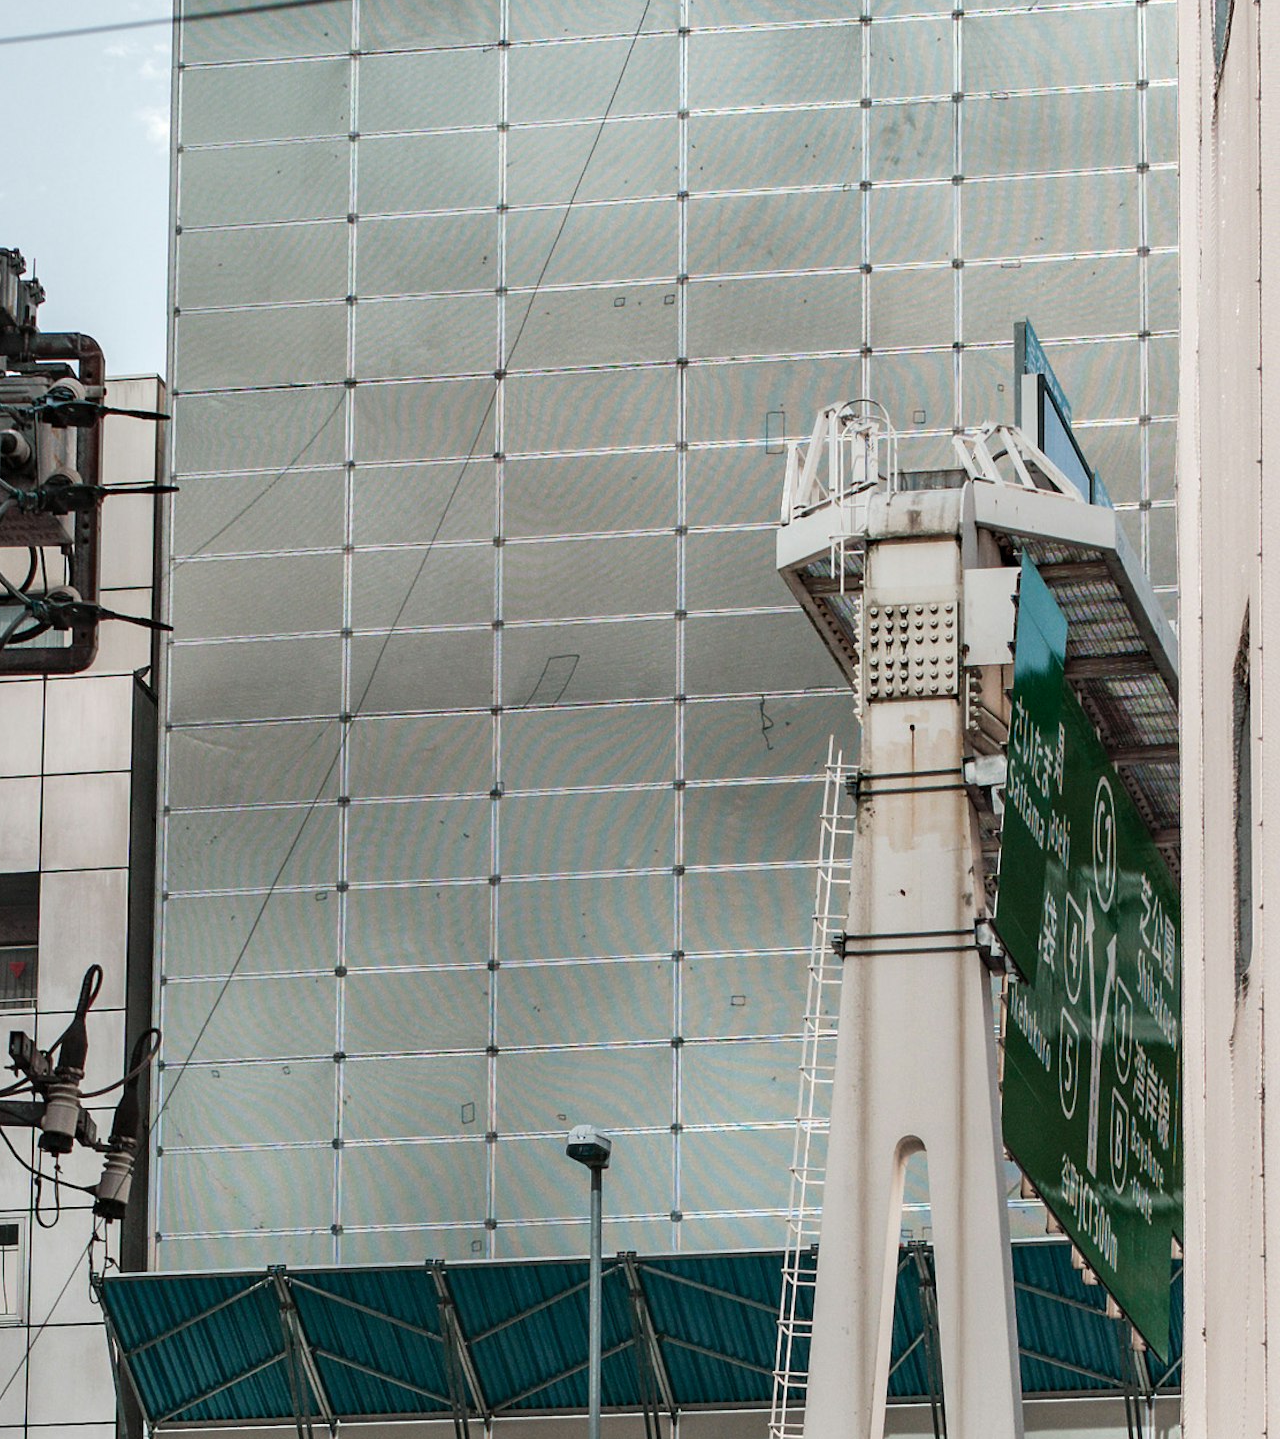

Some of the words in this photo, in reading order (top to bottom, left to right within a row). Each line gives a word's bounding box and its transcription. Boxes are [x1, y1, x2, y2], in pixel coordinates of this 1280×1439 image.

[1013, 695, 1053, 800] さいたま
[1007, 758, 1046, 850] Saitama
[1096, 800, 1113, 890] C1
[1069, 922, 1078, 979] 4
[1139, 872, 1176, 992] 芝公園
[1064, 1034, 1074, 1092] 5
[1118, 1003, 1127, 1062] 1
[1133, 1039, 1170, 1151] 湾岸線
[1114, 1109, 1123, 1170] B
[1130, 1116, 1164, 1195] Bayshore
